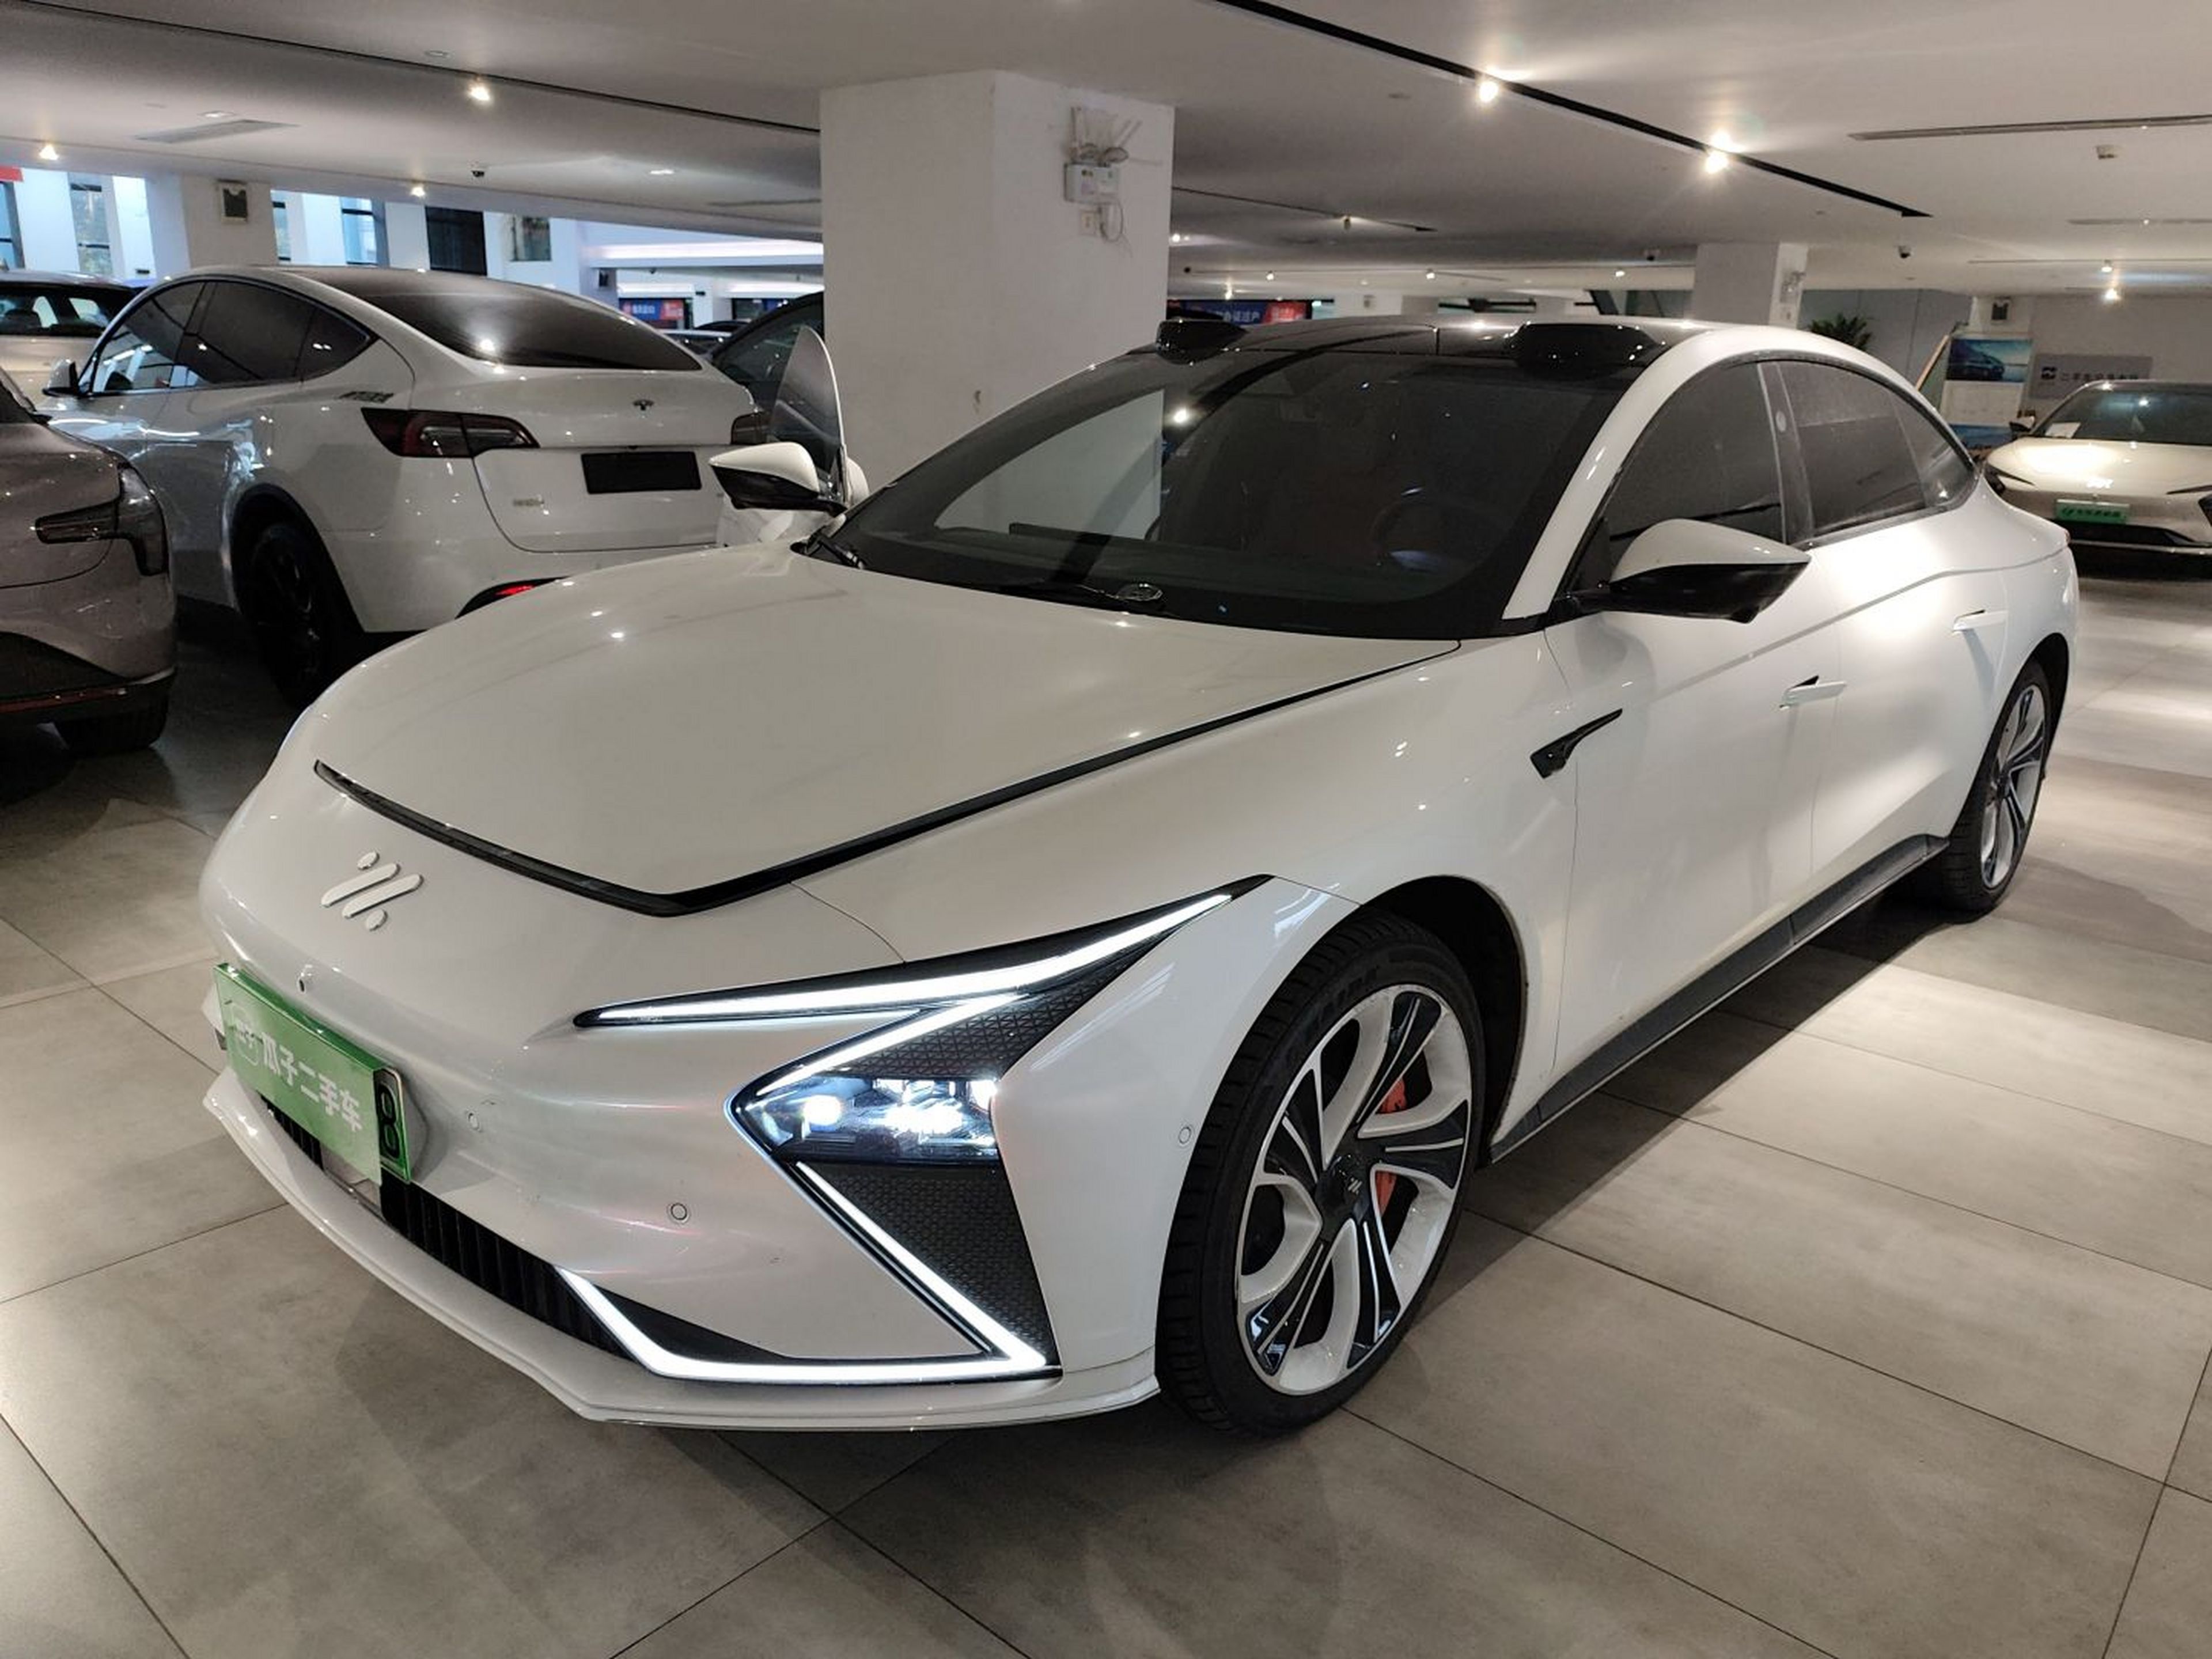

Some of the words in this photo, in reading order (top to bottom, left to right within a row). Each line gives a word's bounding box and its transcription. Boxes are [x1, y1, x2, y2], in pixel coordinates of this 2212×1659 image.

[261, 1032, 363, 1132] 瓜子二手车
